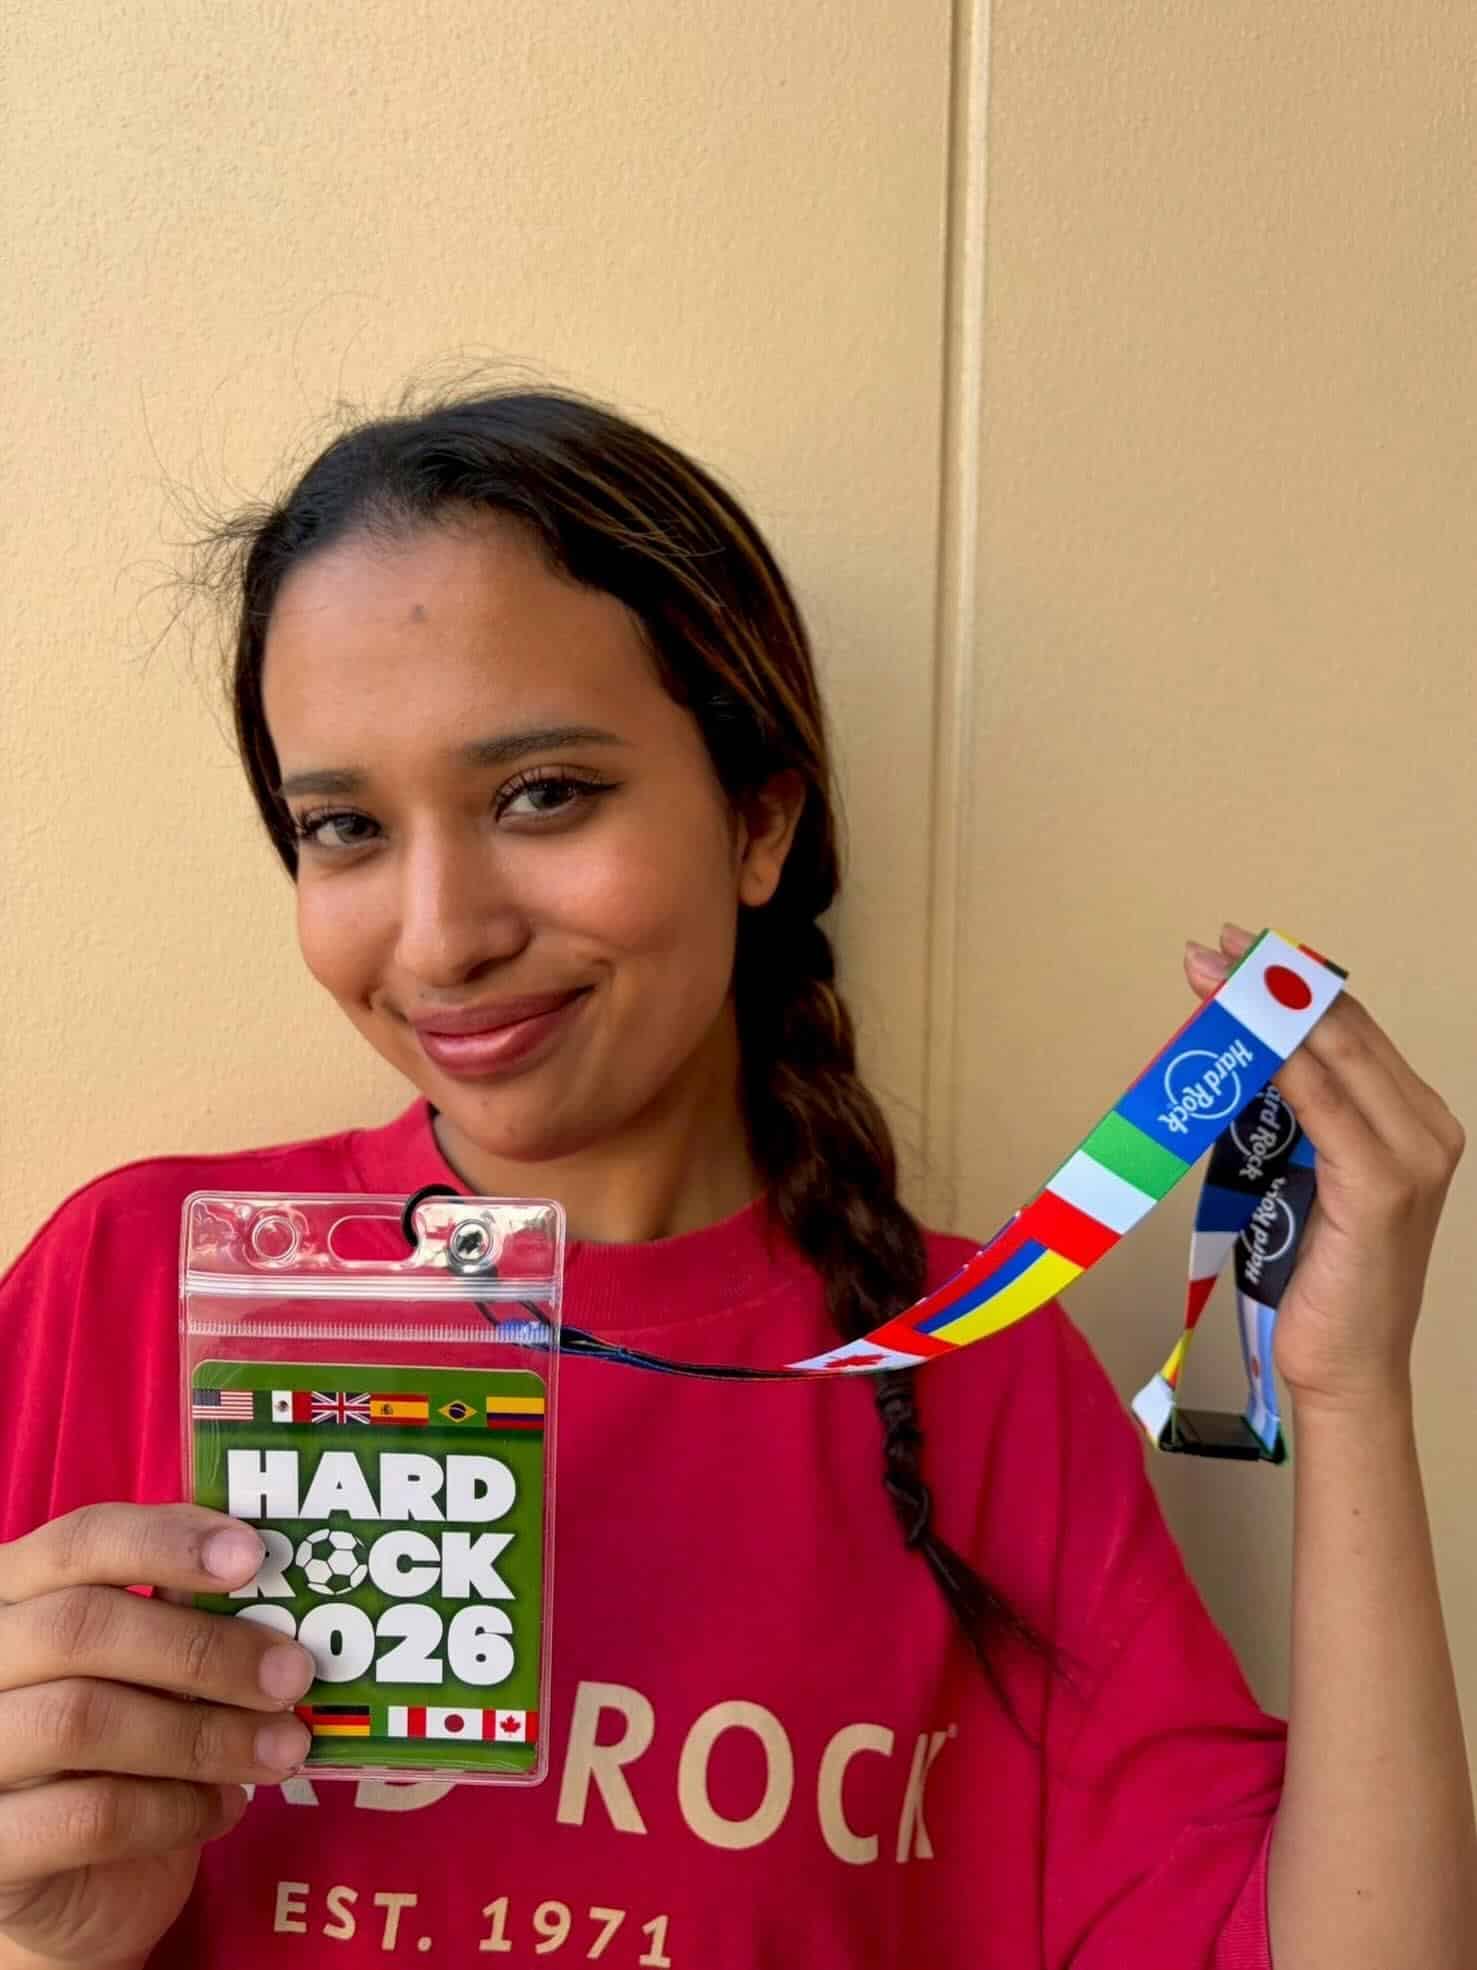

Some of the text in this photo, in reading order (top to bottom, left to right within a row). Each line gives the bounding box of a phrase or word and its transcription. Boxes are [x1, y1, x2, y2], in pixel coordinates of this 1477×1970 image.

[1158, 1040, 1253, 1134] Hard Rock
[1239, 1084, 1281, 1181] ard Rock
[1244, 1223, 1268, 1284] Hard
[226, 1449, 516, 1524] HARD
[235, 1603, 515, 1687] 026
[556, 1681, 948, 1865] ROCK
[273, 1881, 671, 1968] EST. 1971
